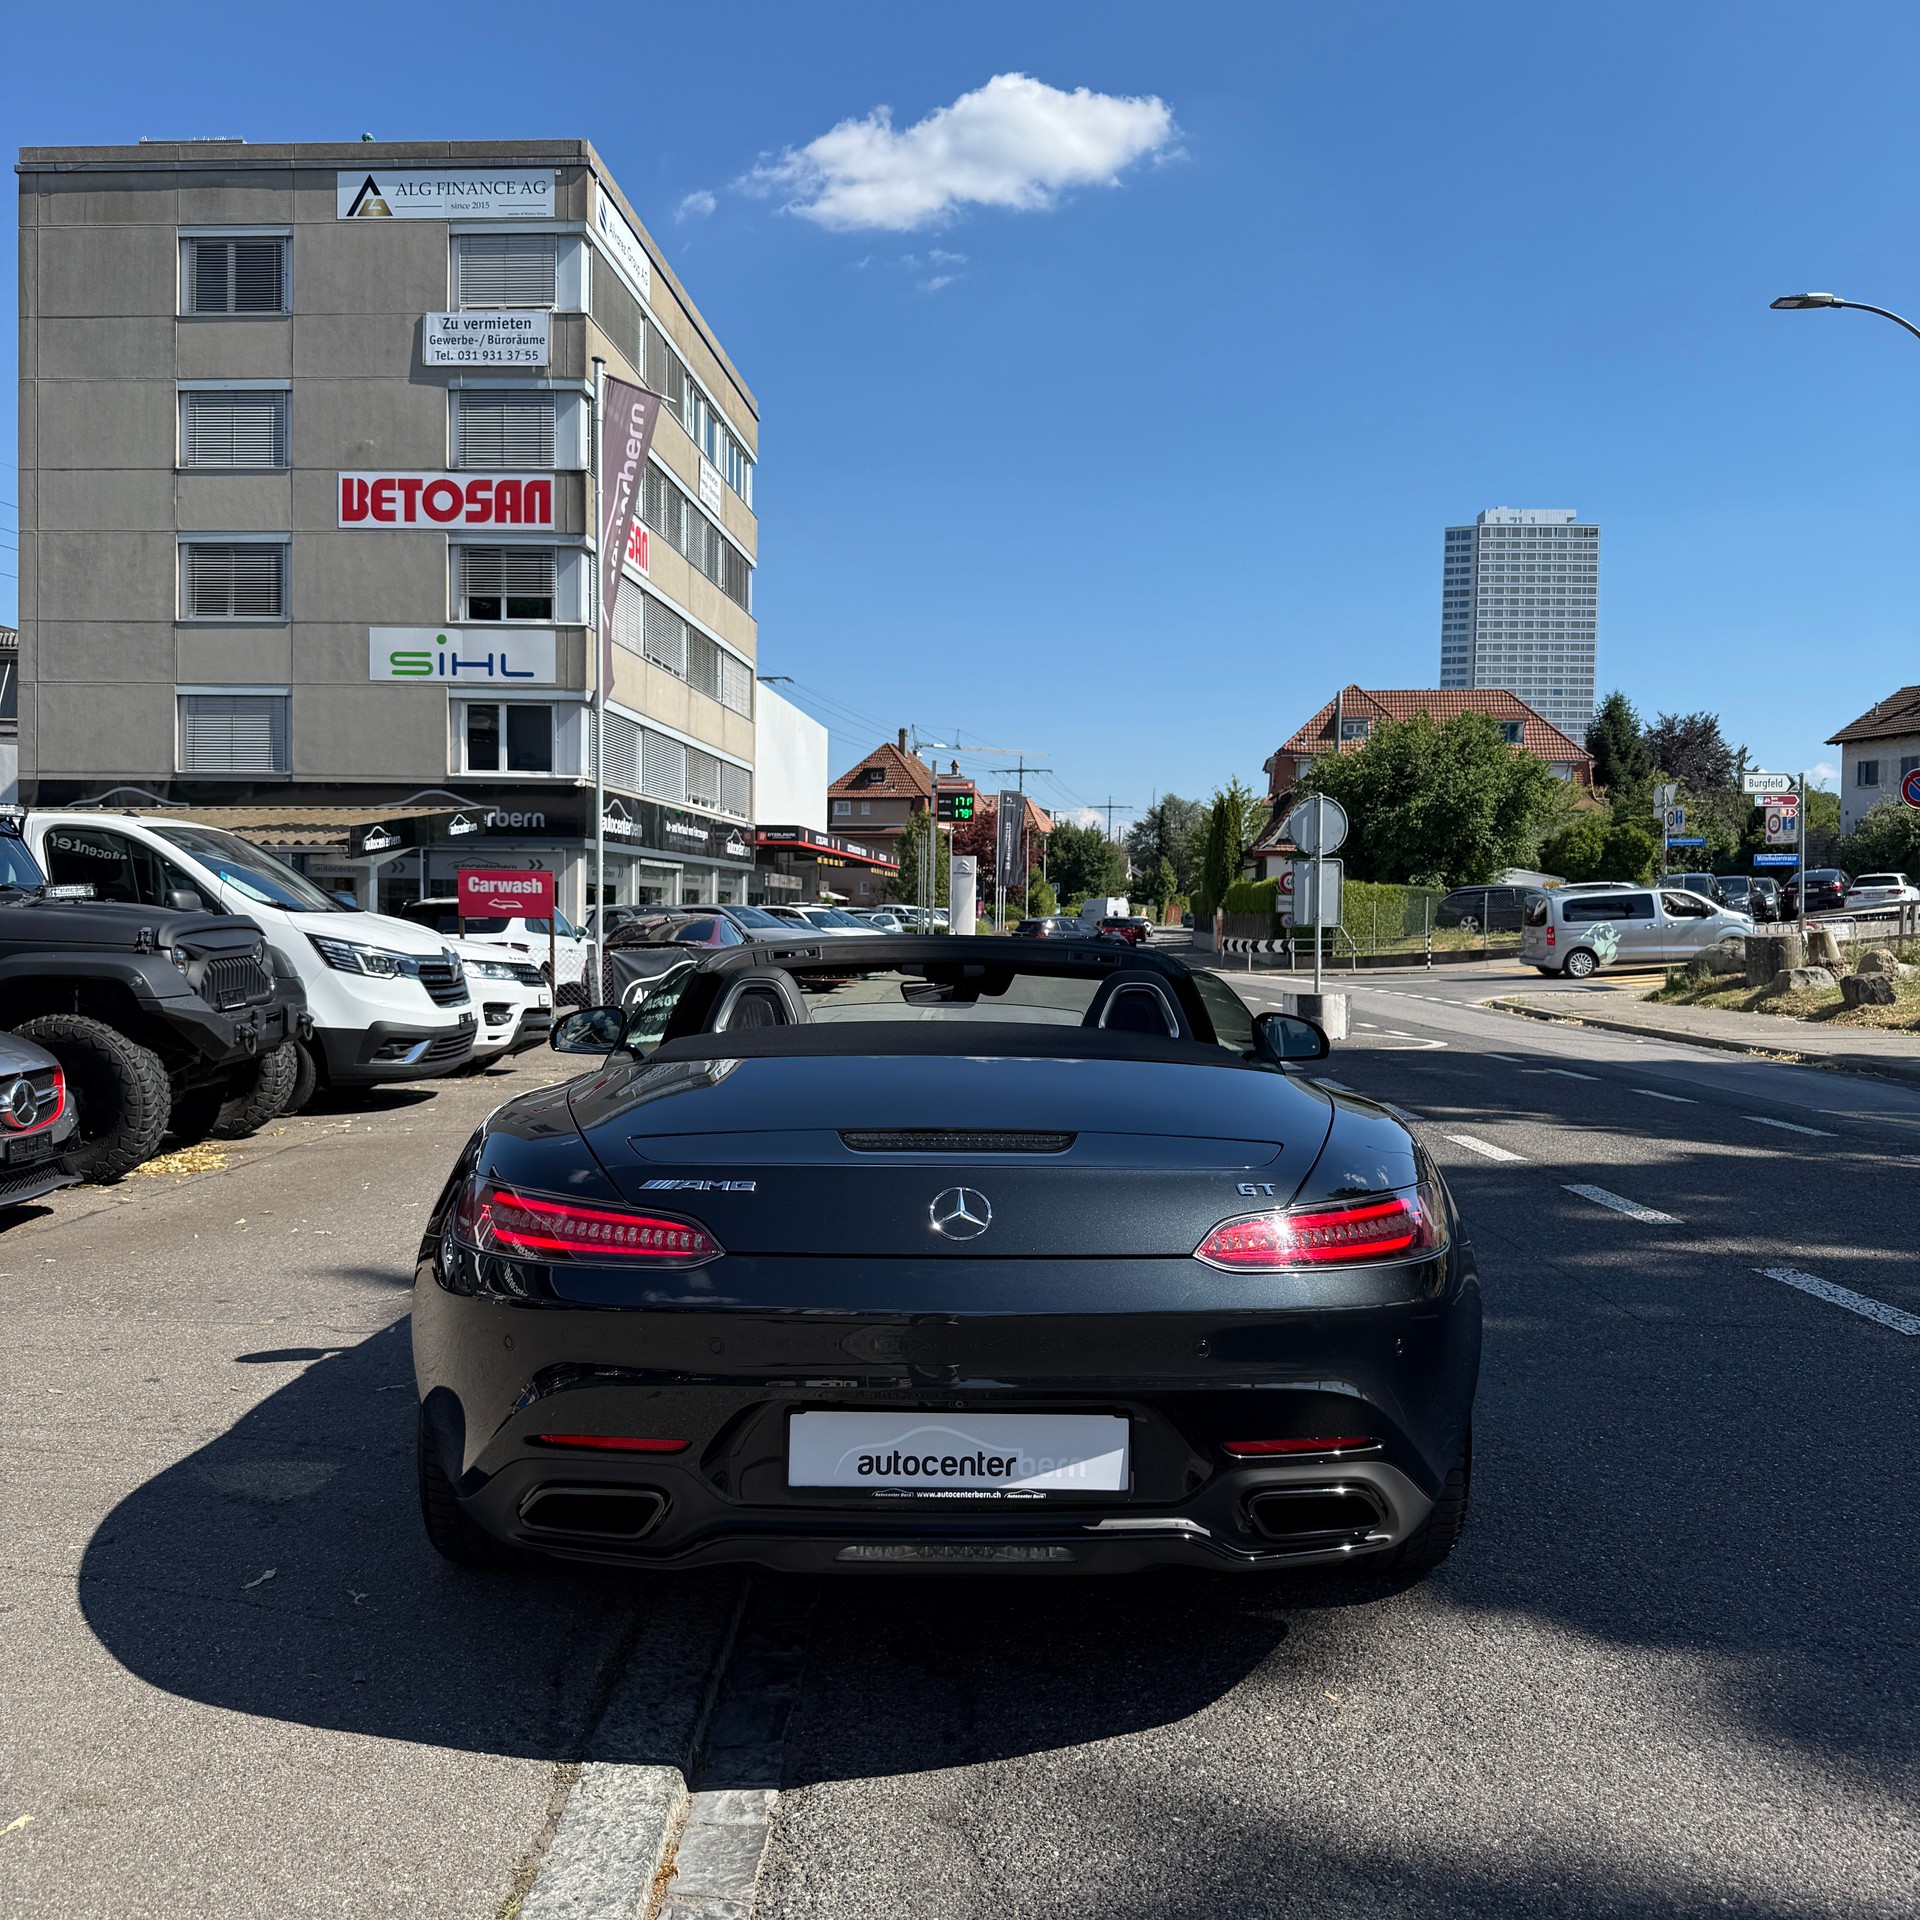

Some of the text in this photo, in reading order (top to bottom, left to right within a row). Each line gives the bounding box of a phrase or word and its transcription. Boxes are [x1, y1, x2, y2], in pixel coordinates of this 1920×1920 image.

[395, 180, 547, 196] ALG FINANCE AG
[450, 201, 490, 210] since 2015
[442, 317, 532, 330] Zu vermieten
[487, 335, 546, 345] Büroräume
[435, 350, 539, 360] Tel. 031 931 37 55
[342, 478, 552, 524] BETOSAN
[1748, 778, 1783, 790] Burgfeld
[467, 876, 543, 894] Carwash
[1236, 1183, 1276, 1196] GT
[916, 1490, 1002, 1499] www.autocenterbern.ch
